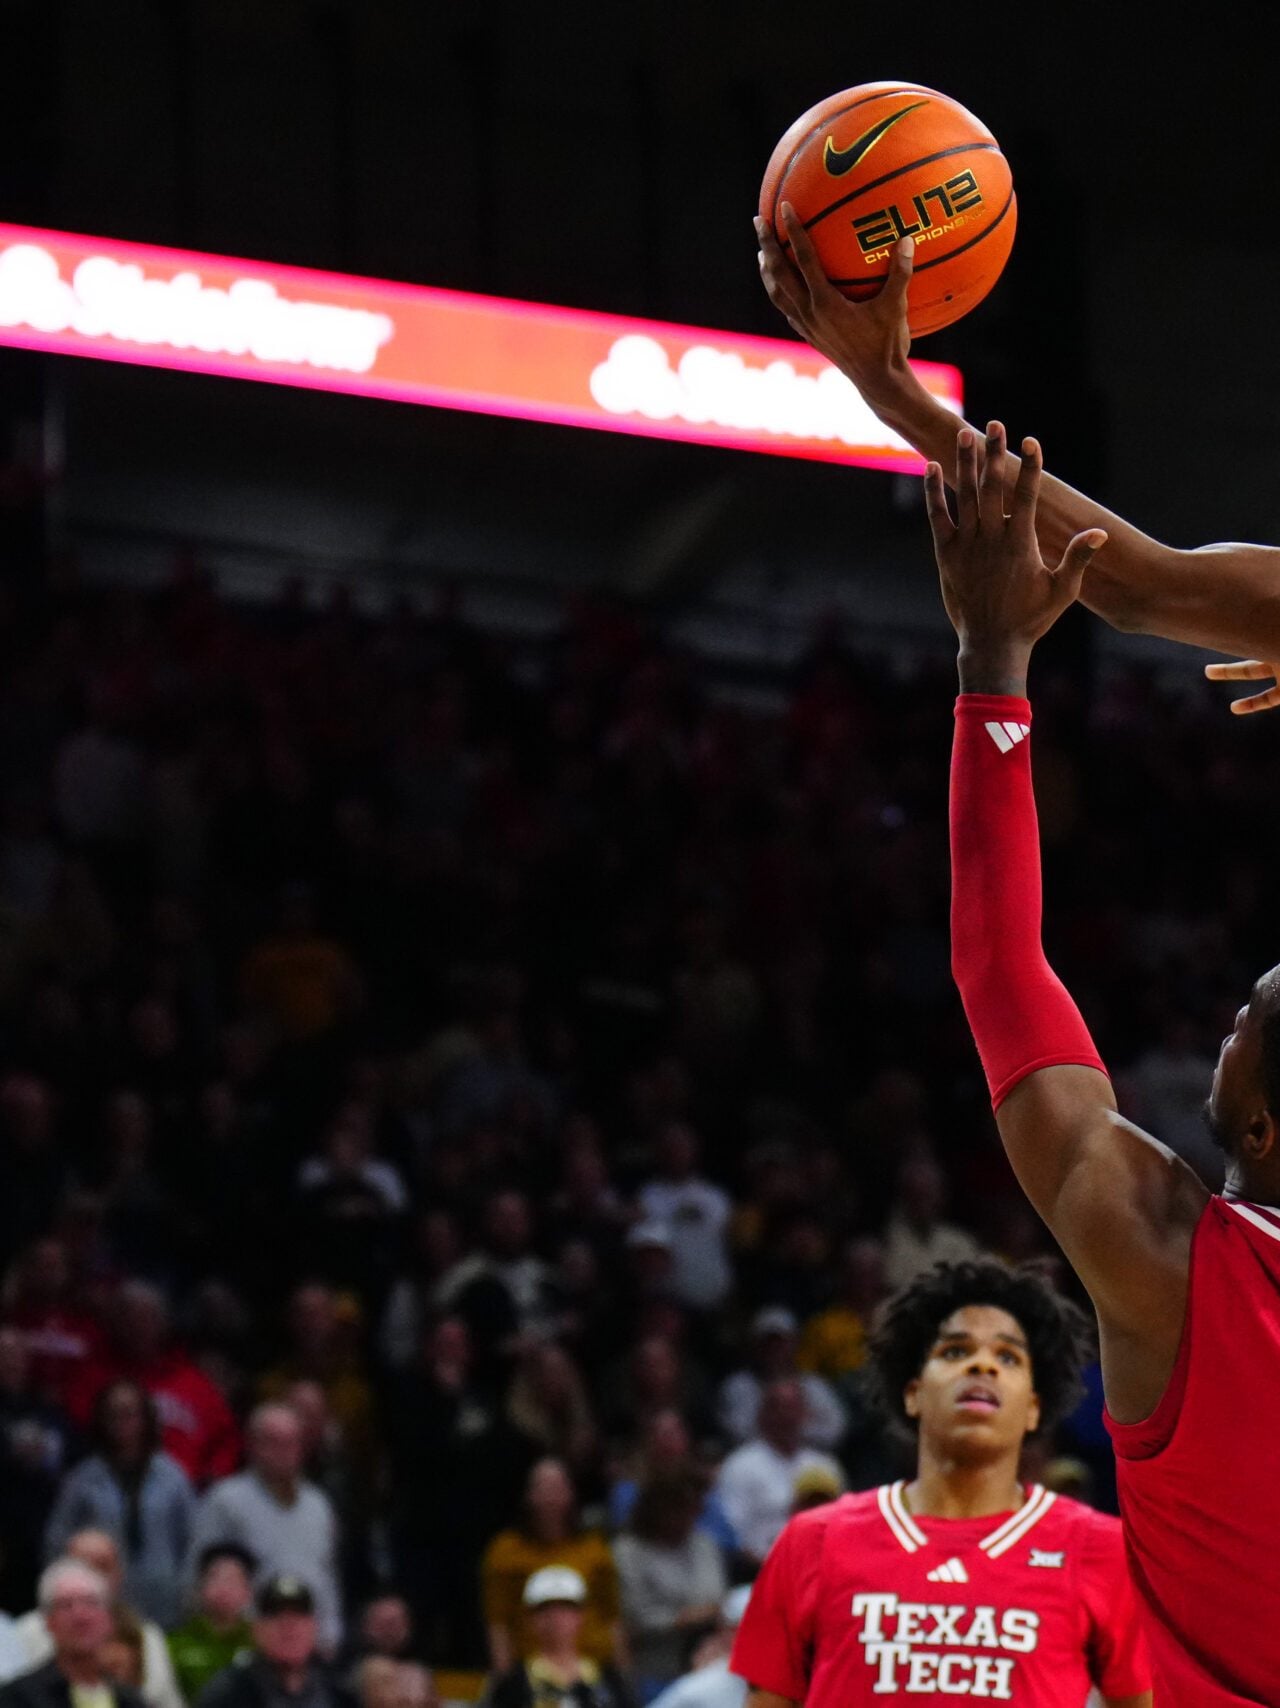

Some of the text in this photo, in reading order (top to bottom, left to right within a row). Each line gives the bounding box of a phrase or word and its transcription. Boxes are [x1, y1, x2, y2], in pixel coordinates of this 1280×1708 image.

[851, 167, 983, 254] ELITE
[851, 1592, 1041, 1654] TEXAS
[864, 1641, 1016, 1700] TECH
